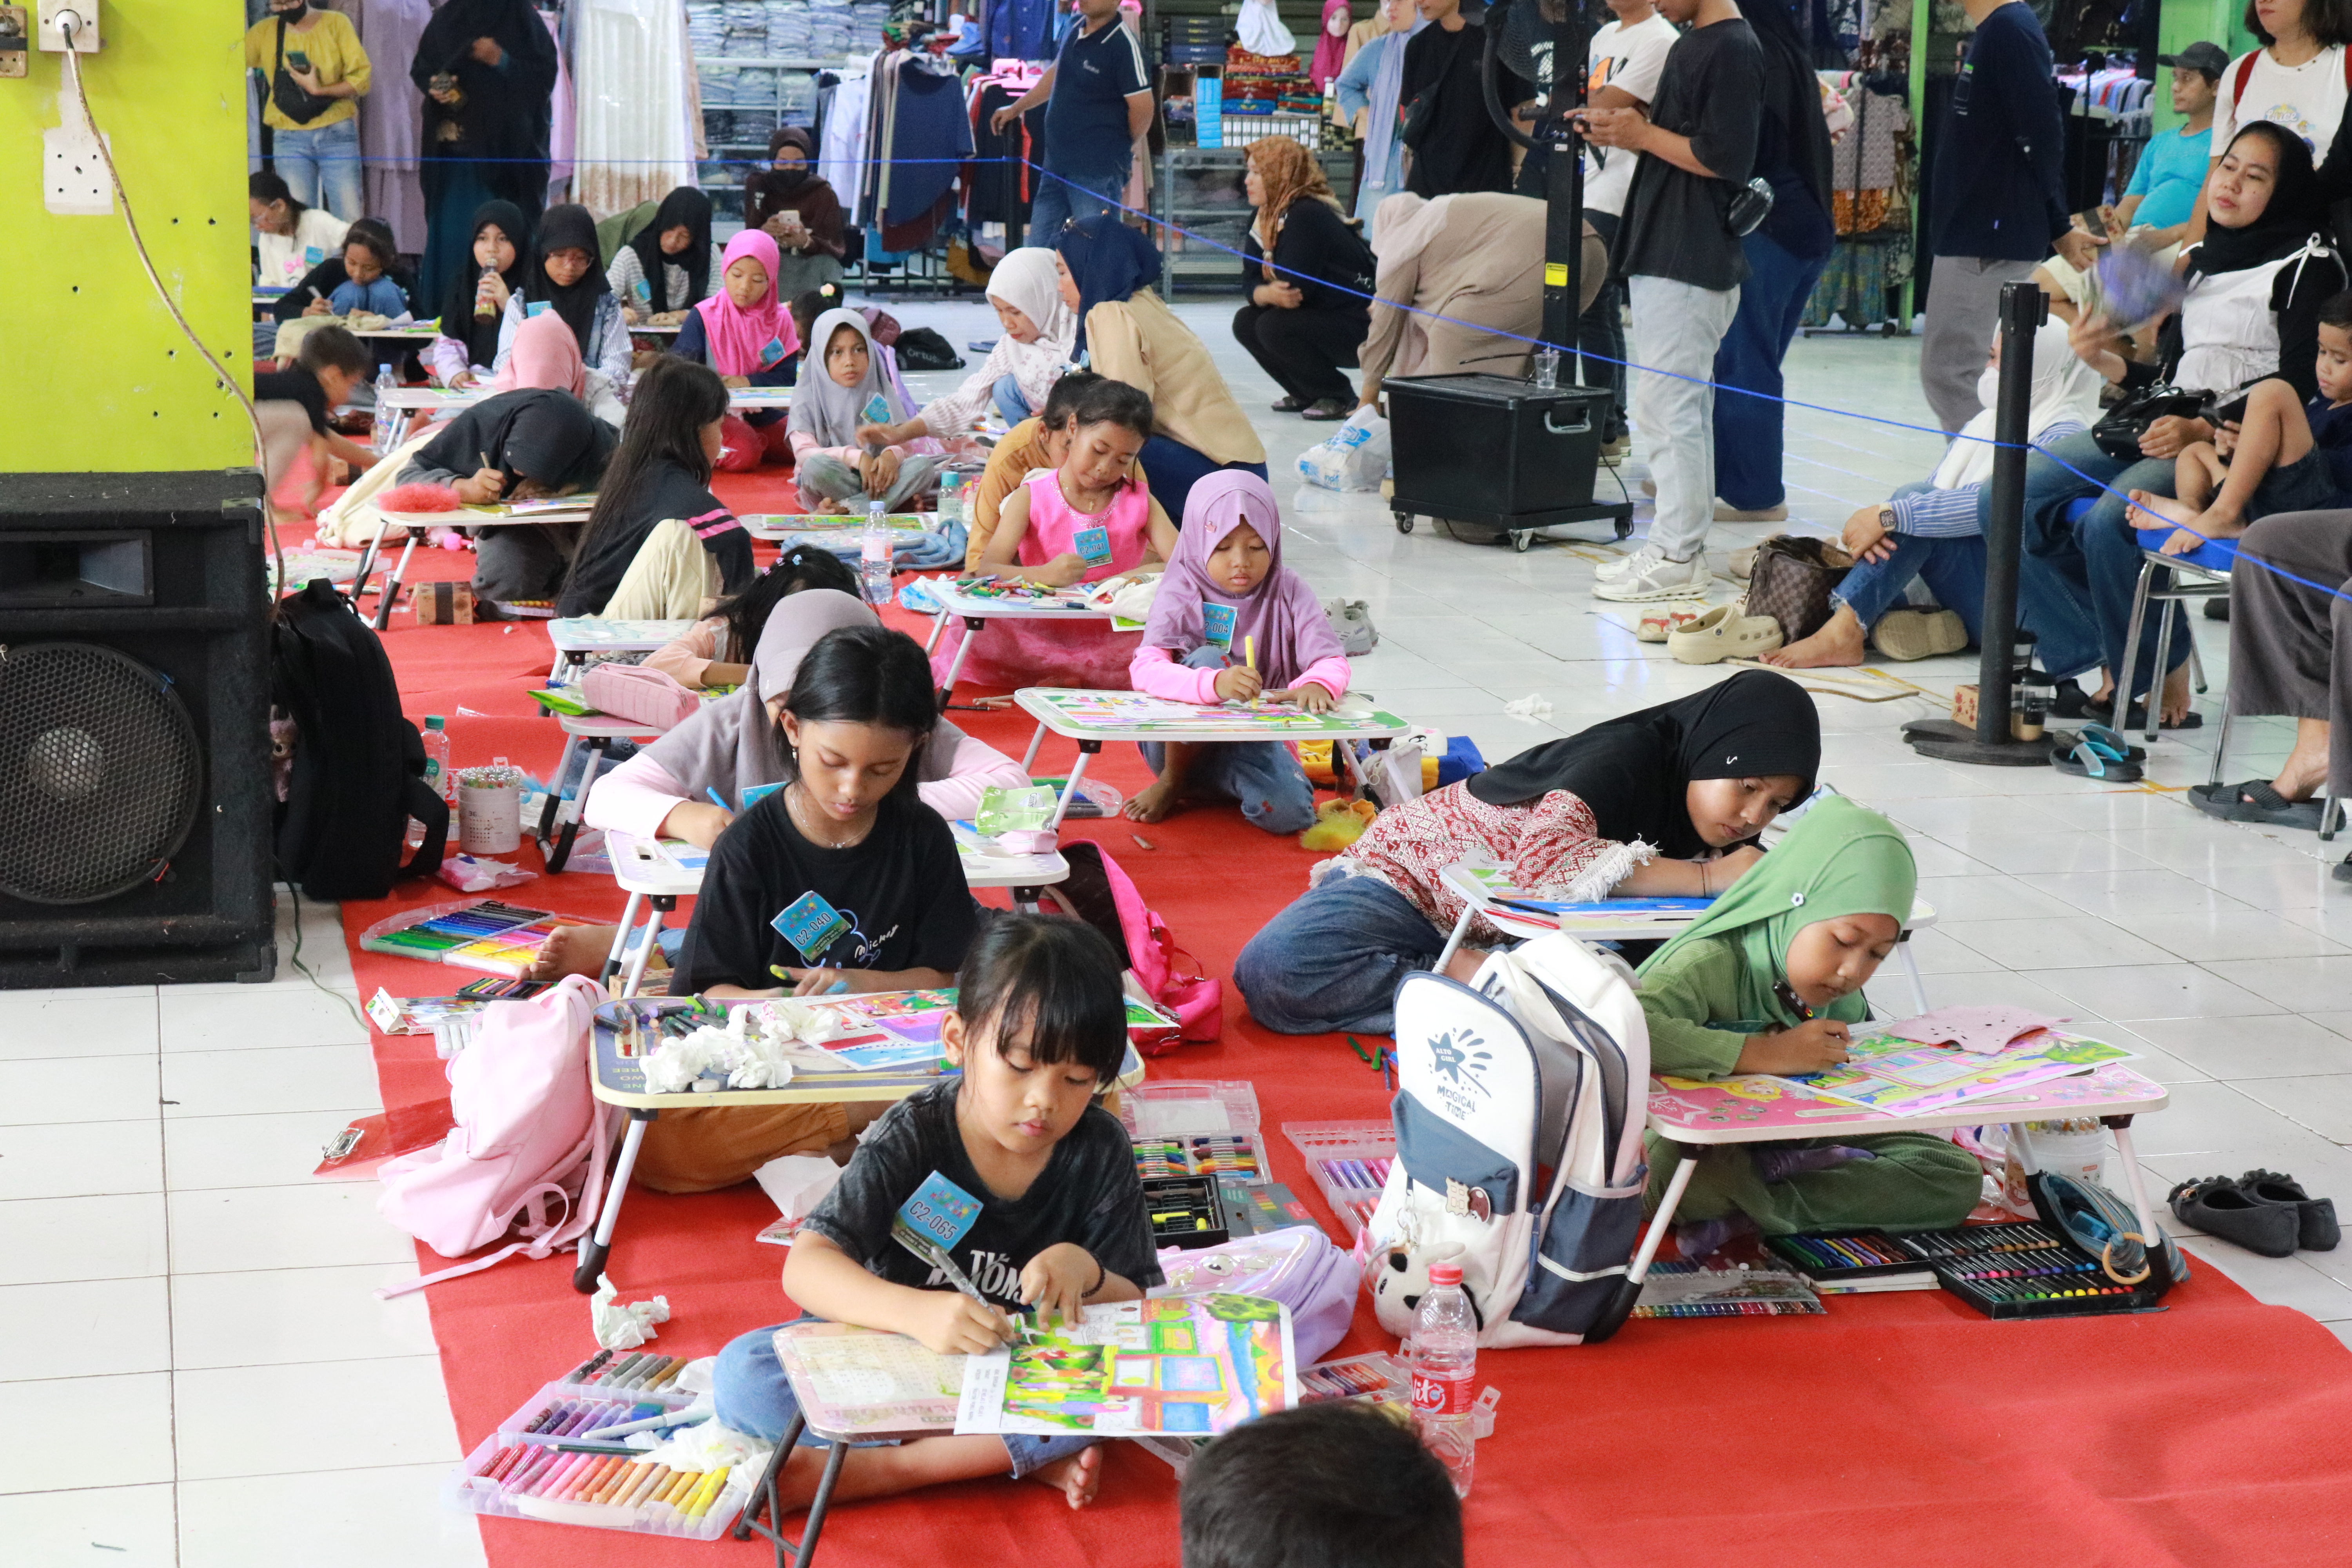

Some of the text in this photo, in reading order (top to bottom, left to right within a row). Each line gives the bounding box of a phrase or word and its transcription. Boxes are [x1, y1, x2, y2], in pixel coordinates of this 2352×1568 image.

[1205, 621, 1229, 634] 2-004
[795, 912, 832, 946] C2-040
[909, 1201, 958, 1240] C2-065
